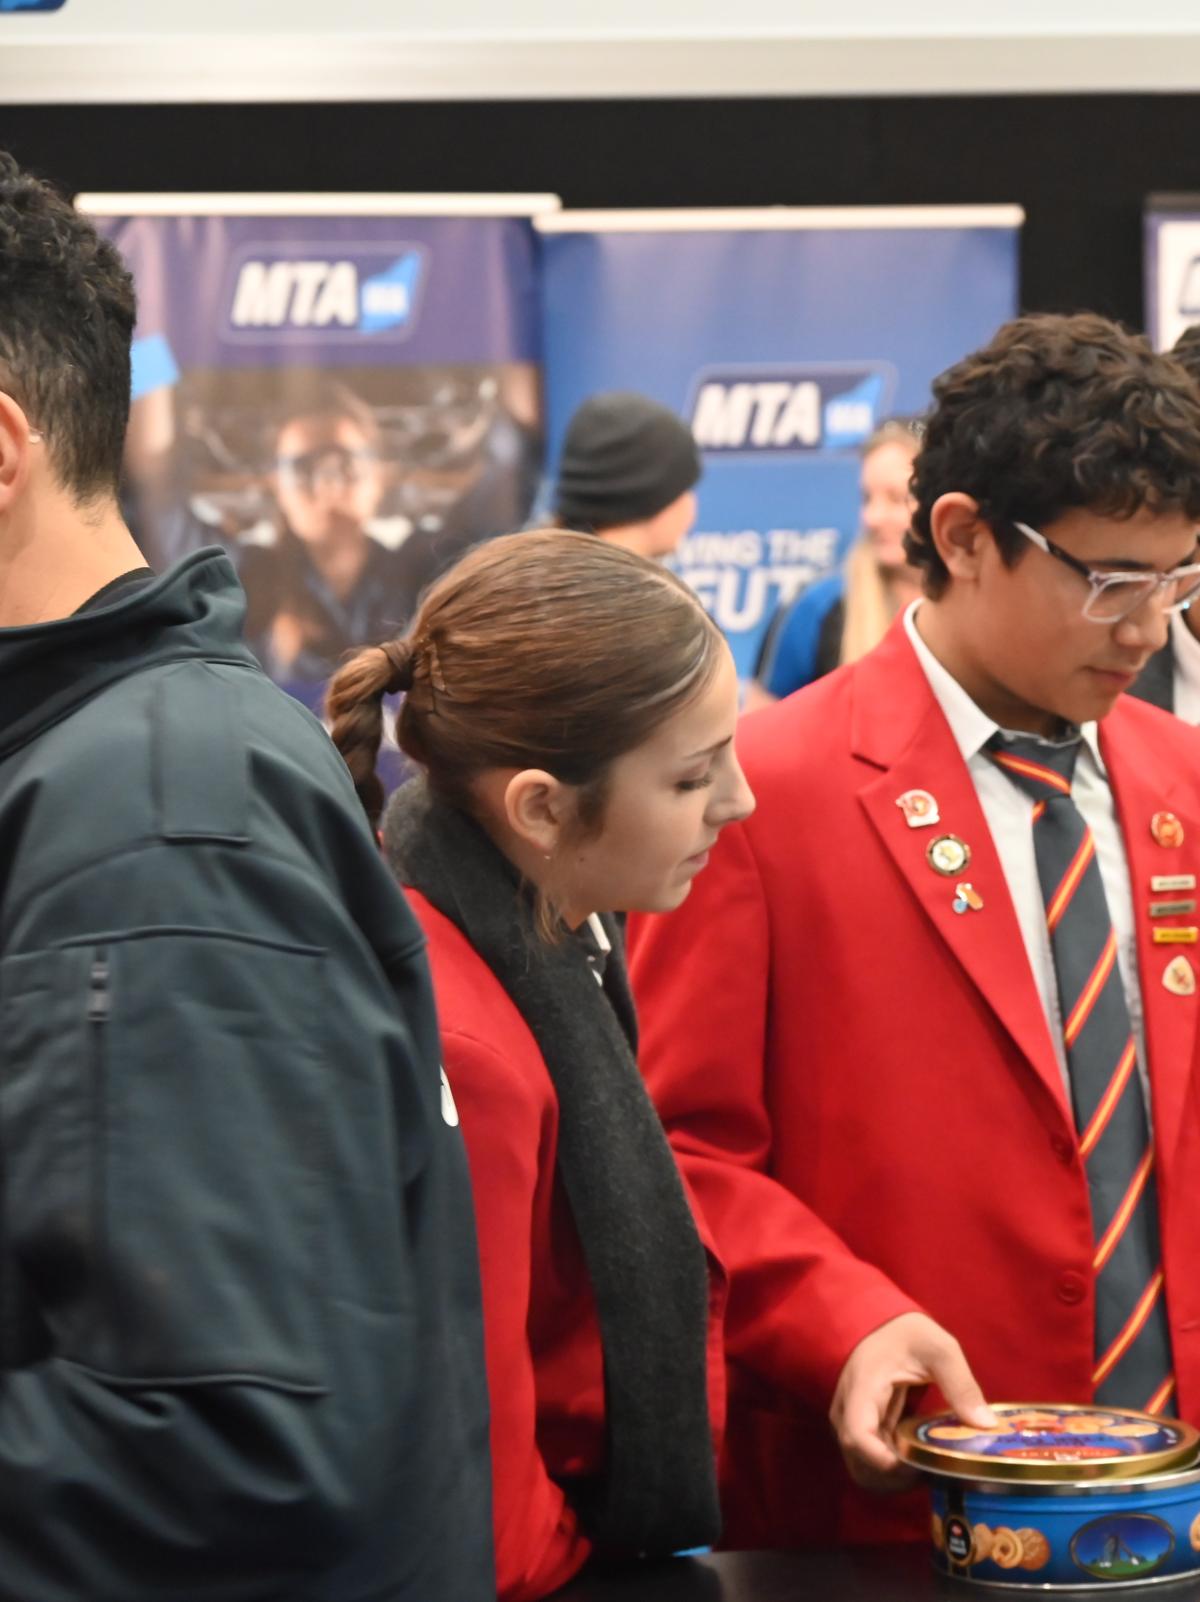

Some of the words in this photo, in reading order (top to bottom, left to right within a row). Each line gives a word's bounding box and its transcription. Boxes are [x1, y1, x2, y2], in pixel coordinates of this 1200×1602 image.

[231, 260, 358, 327] MTA
[692, 381, 821, 448] MTA
[682, 566, 817, 632] FUT
